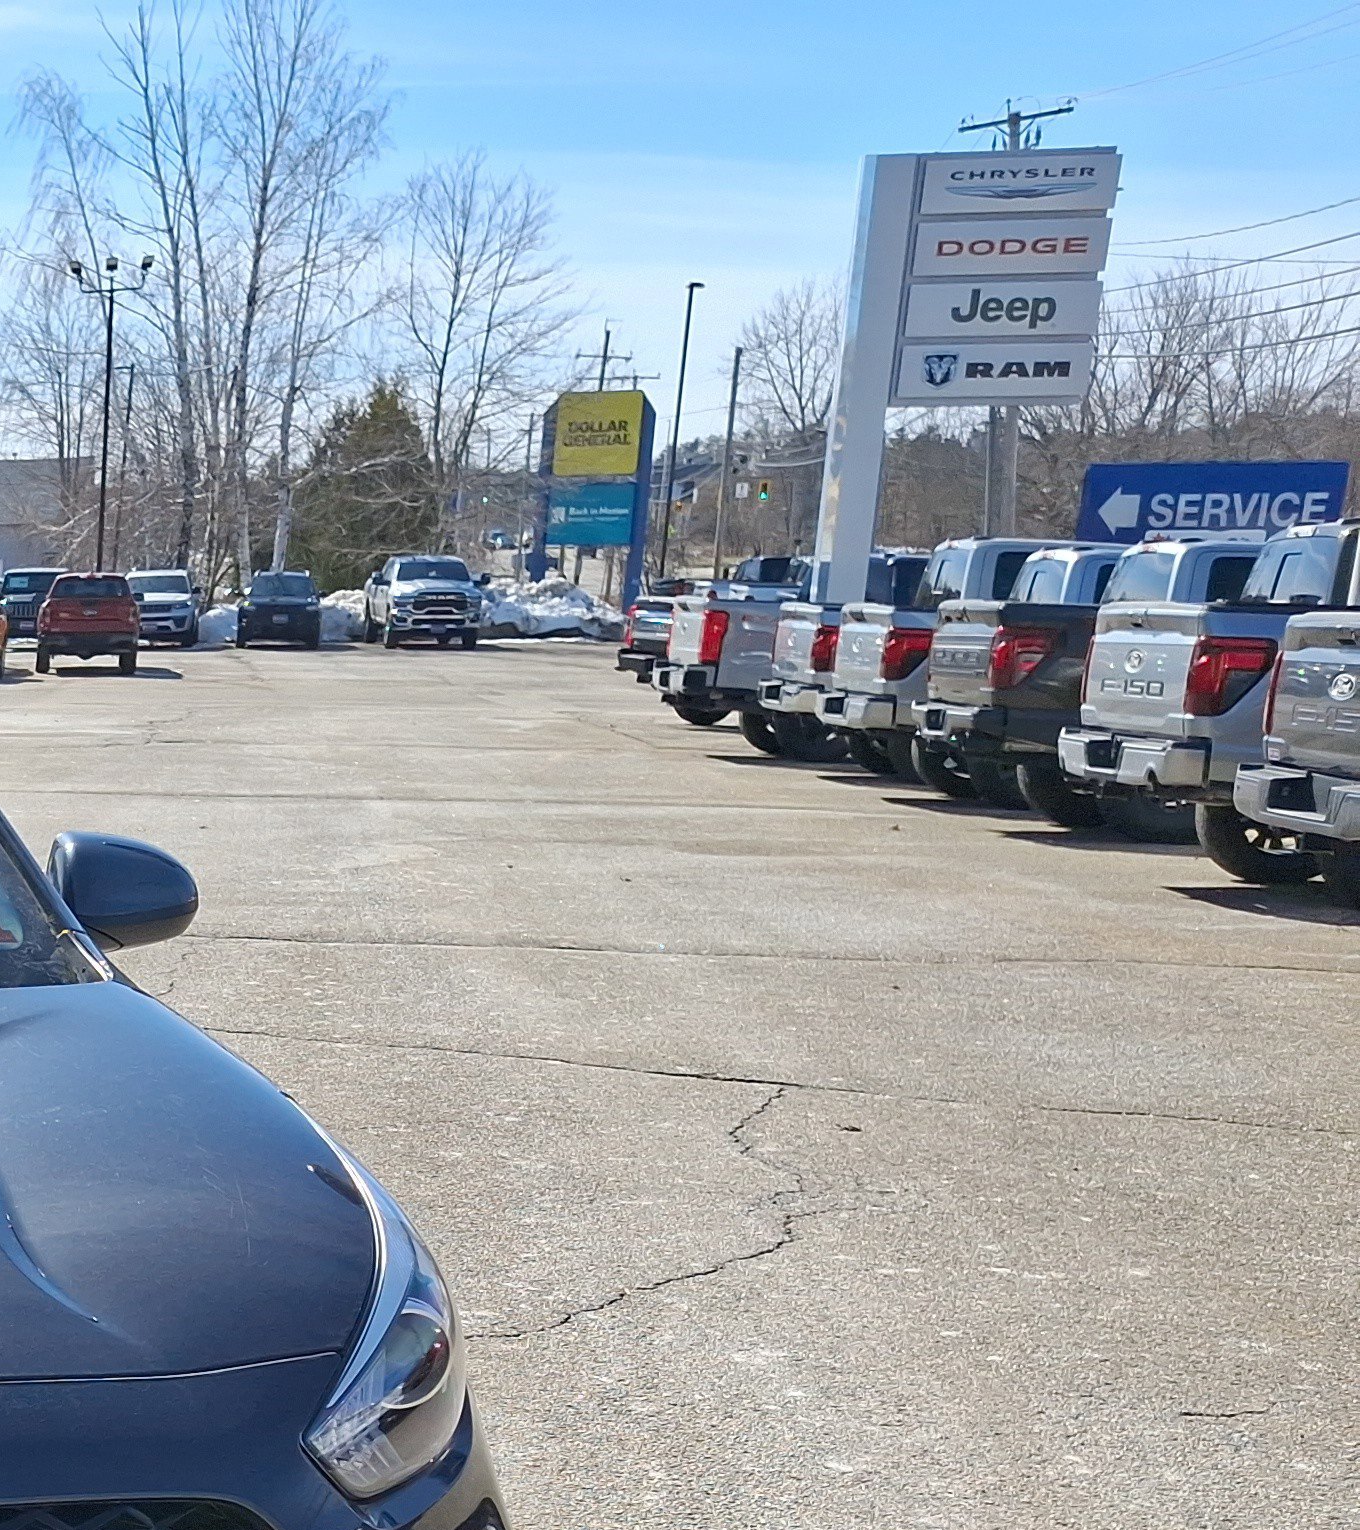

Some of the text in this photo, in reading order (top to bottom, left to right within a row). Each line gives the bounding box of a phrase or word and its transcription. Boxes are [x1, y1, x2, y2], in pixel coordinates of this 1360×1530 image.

[950, 167, 1096, 181] CHRYSLER
[936, 236, 1090, 257] DODGE
[951, 288, 1057, 329] Jeep
[964, 361, 1071, 379] RAM
[568, 420, 629, 433] DOLLAR
[1147, 492, 1330, 528] SERVICE
[1100, 678, 1165, 697] F-150
[1292, 703, 1360, 733] F-15
